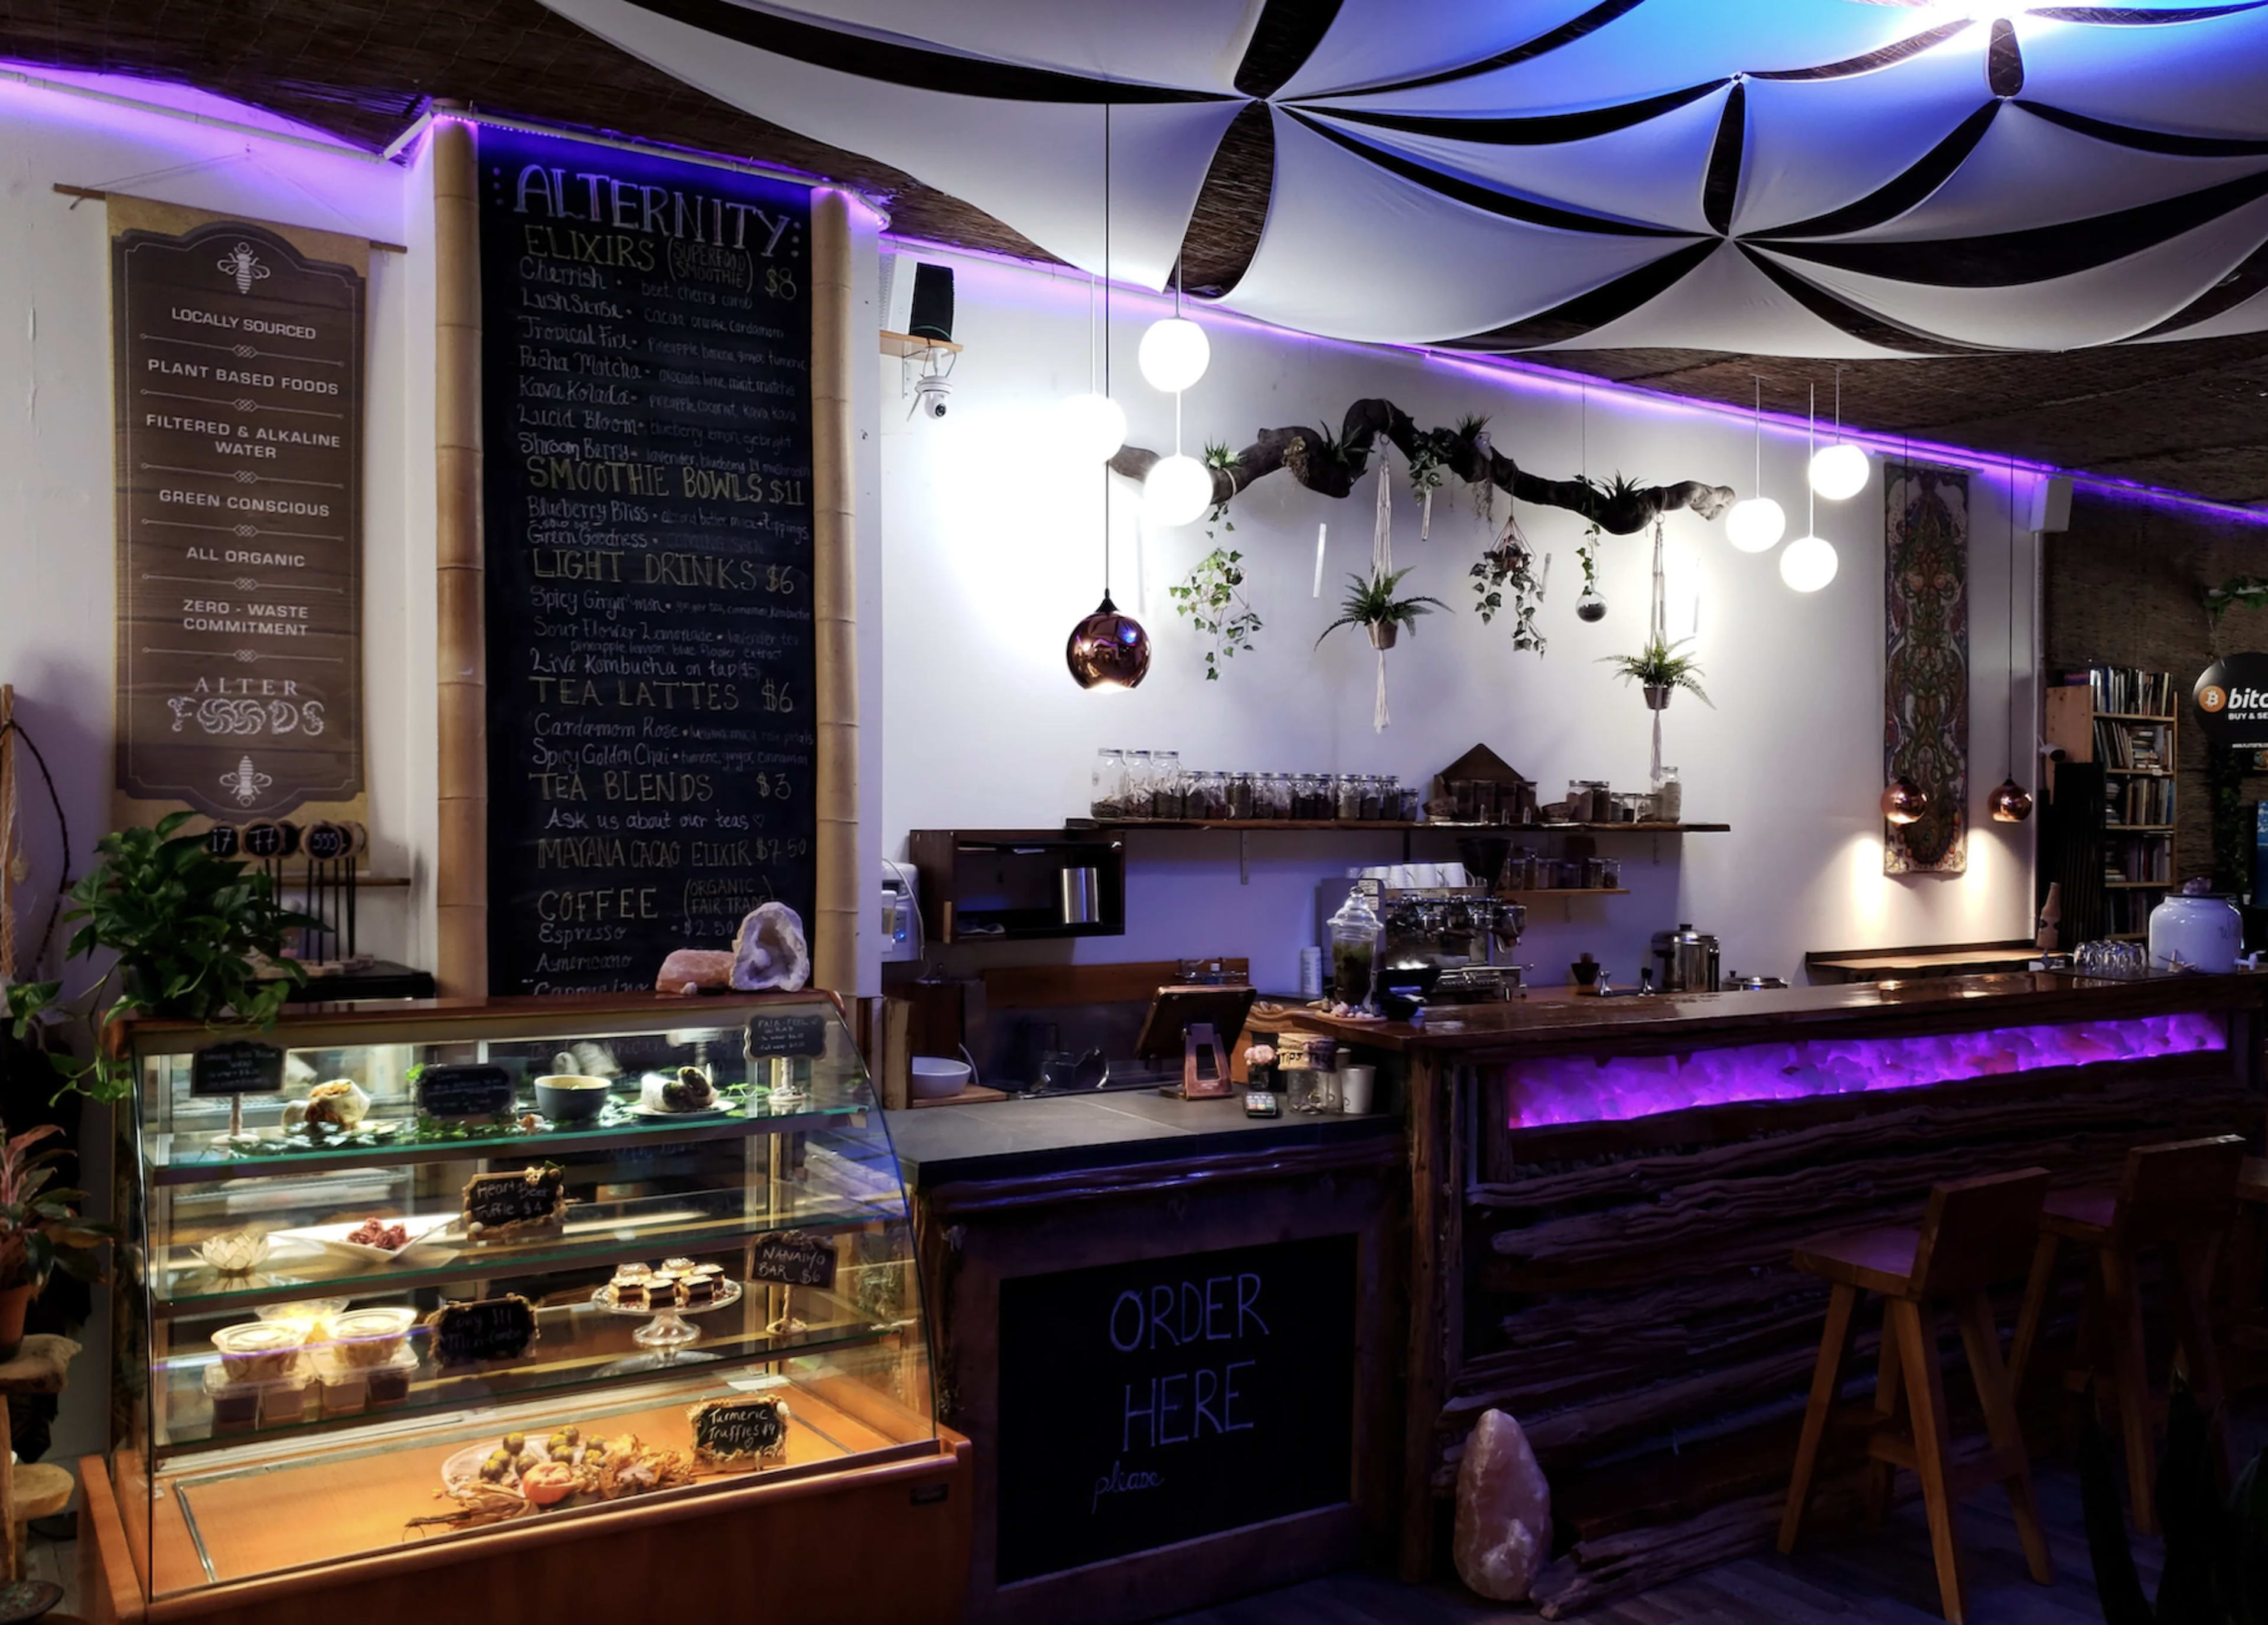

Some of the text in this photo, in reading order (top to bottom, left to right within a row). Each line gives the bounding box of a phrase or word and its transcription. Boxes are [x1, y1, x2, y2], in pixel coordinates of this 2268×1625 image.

[514, 164, 790, 256] ALTERNITY
[524, 224, 797, 301] ELIXIRS $8
[172, 307, 316, 340] LOCALLY SOURCED
[517, 315, 596, 346] Tropical
[598, 324, 633, 350] Fire
[148, 359, 338, 395] PLANT BASED FOODS
[519, 345, 571, 373] Pacha
[573, 351, 643, 379] Matcha
[519, 374, 565, 399] Kava
[146, 415, 341, 448] FILTERED & ALKALINE
[517, 403, 577, 428] Lucid
[584, 409, 638, 436] Bloom
[215, 441, 276, 459] WATER
[517, 432, 581, 462] Shroom
[583, 437, 630, 461] Berry
[526, 455, 806, 506] SMOOTHIE BOWLS $11
[159, 489, 330, 517] GREEN CONSCIOUS
[526, 495, 607, 523] Blueberry
[610, 500, 649, 523] Bliss
[526, 523, 577, 545] Green
[578, 527, 649, 549] Goodness
[187, 546, 306, 567] ALL ORGANIC
[533, 548, 795, 594] LIGHT DRINKS $6
[183, 600, 230, 614] ZERO
[247, 604, 308, 618] WASTE
[530, 584, 578, 617] Spicy
[183, 618, 308, 636] COMMITMENT
[533, 615, 579, 638] Sour
[581, 617, 637, 640] Flower
[639, 621, 714, 643] Lemonade
[529, 646, 577, 675] Live
[584, 653, 677, 676] Kombucha
[685, 662, 702, 676] on
[708, 656, 738, 679] tap
[194, 676, 299, 696] ALTER
[529, 676, 793, 712] TEA LATTES $6
[167, 696, 324, 736] FOODS
[534, 712, 636, 738] Cardamom
[642, 715, 680, 739] Rose
[532, 737, 579, 774] Spicy
[582, 743, 633, 766] Golden
[634, 741, 670, 768] Chai
[528, 771, 588, 802] TEA
[603, 769, 714, 802] BLENDS
[544, 806, 750, 831] Ask us about our teas
[629, 839, 682, 869] CACAO
[690, 839, 752, 868] ELIXIR
[537, 887, 659, 923] COFFEE
[690, 897, 723, 915] FAIR
[538, 921, 627, 950] Espresso
[535, 951, 633, 973] Americano
[758, 1261, 822, 1285] BAR $6
[762, 1246, 826, 1271] NANAIMO
[1109, 1272, 1270, 1352] ORDER
[708, 1407, 768, 1425] Turmeric
[1122, 1359, 1256, 1453] HERE
[708, 1423, 760, 1443] Truffles
[1091, 1459, 1165, 1515] please
